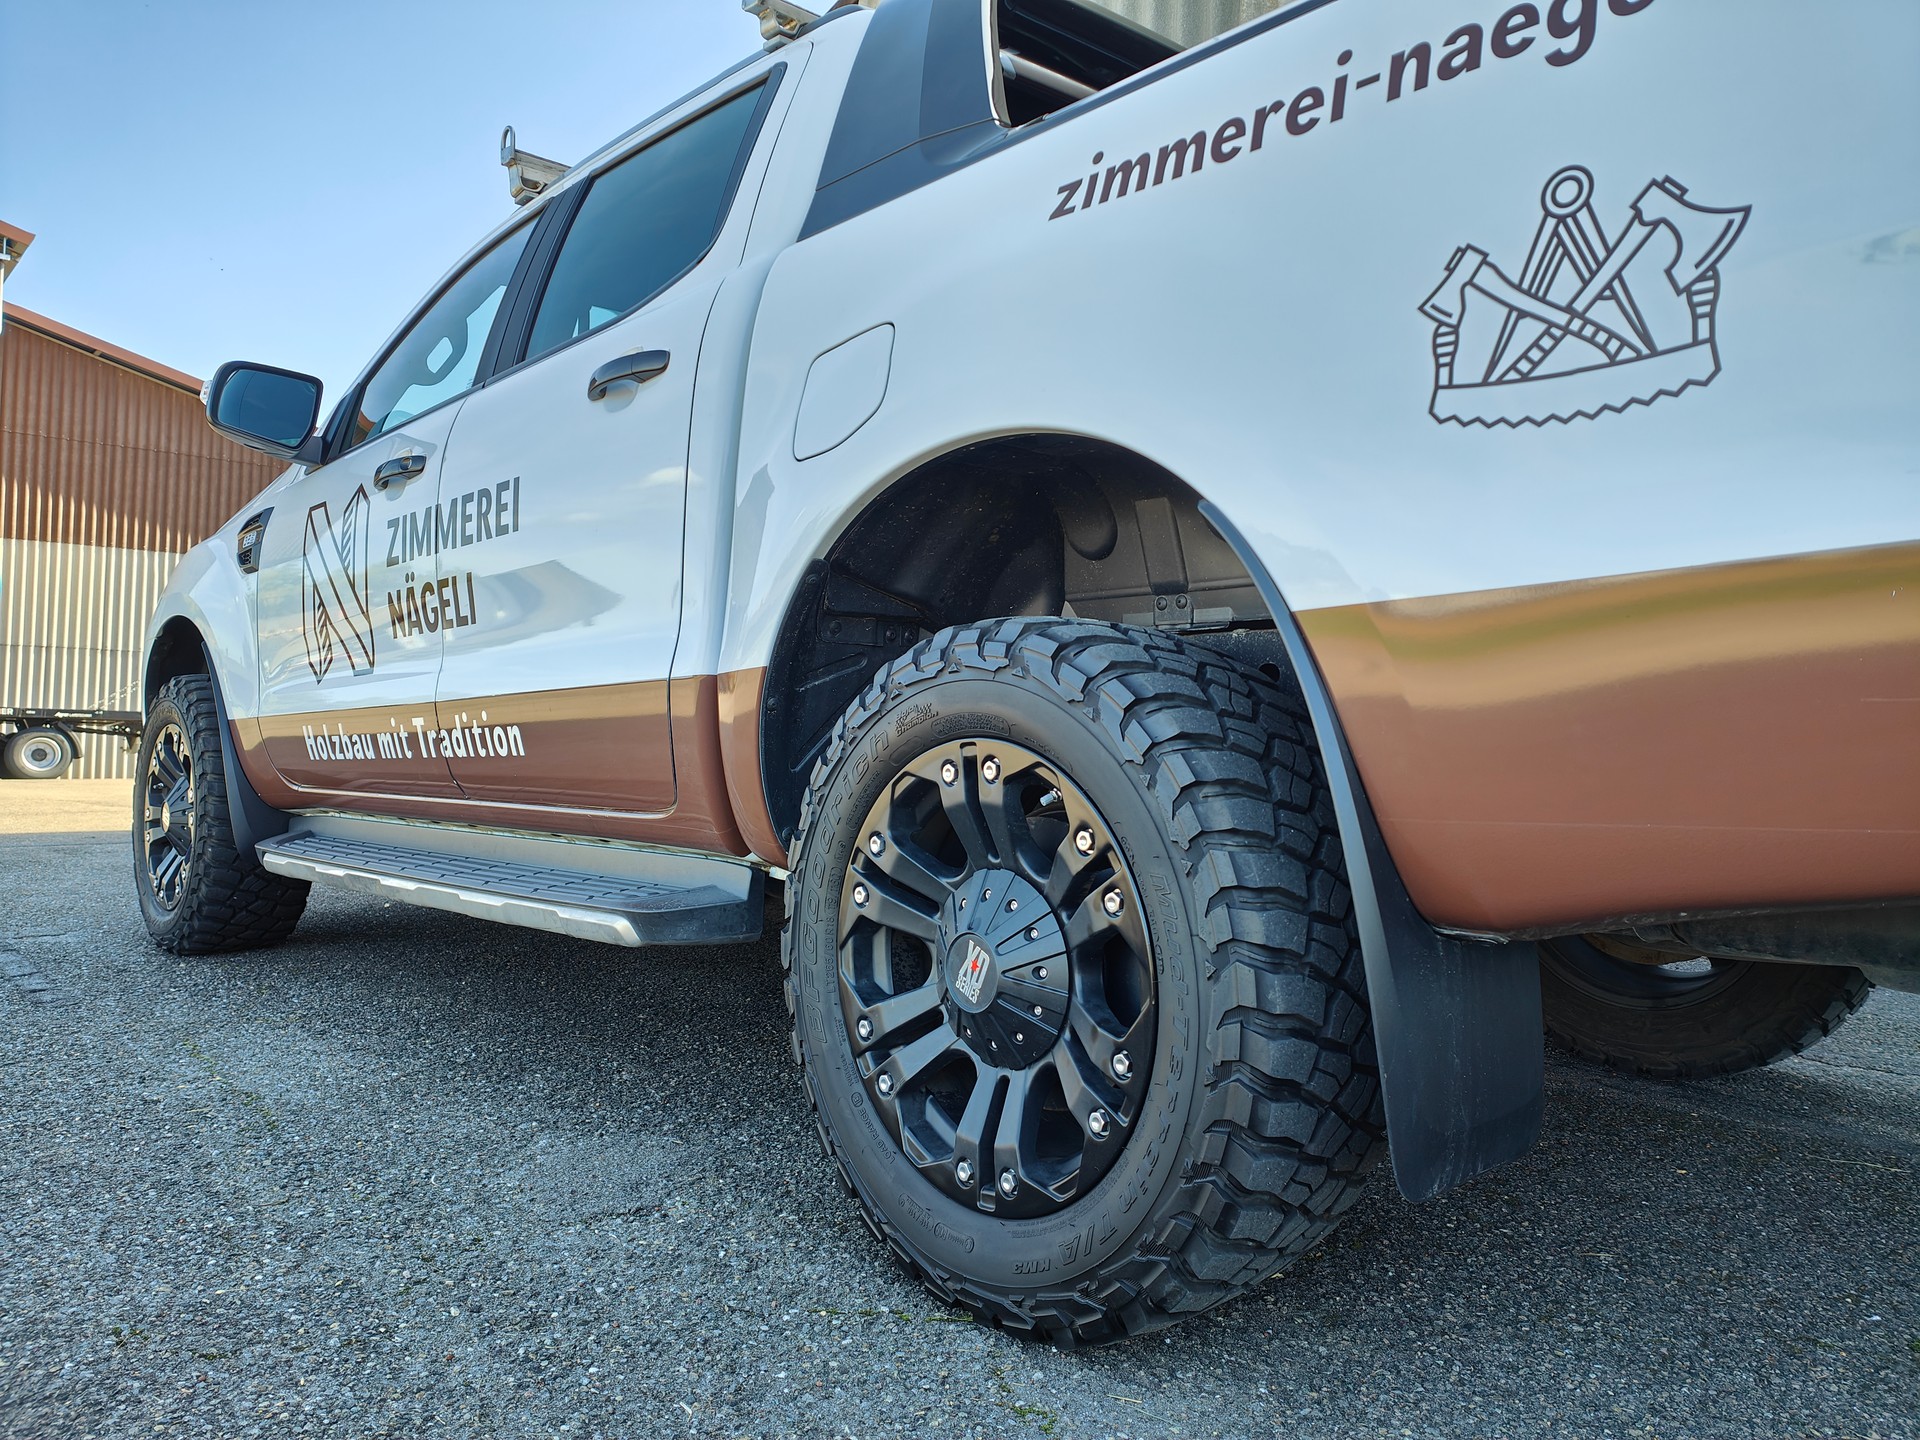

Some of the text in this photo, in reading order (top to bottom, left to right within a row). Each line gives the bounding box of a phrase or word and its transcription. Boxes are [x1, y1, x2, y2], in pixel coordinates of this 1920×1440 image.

[1048, 0, 1656, 222] zimmerei-naeg
[386, 476, 520, 567] ZIMMEREI
[387, 571, 477, 640] NÄGELI
[302, 710, 526, 761] Holzbau mit Tradition
[896, 711, 939, 737] Champion
[803, 730, 890, 1044] BFGoodrich
[955, 974, 980, 1004] SERIES
[958, 939, 990, 989] XD
[1119, 873, 1190, 1214] Mud-Terrain
[858, 1107, 880, 1141] RANGE
[876, 1137, 896, 1165] LOAD
[1057, 1208, 1118, 1267] T/A
[1012, 1258, 1052, 1275] KM3
